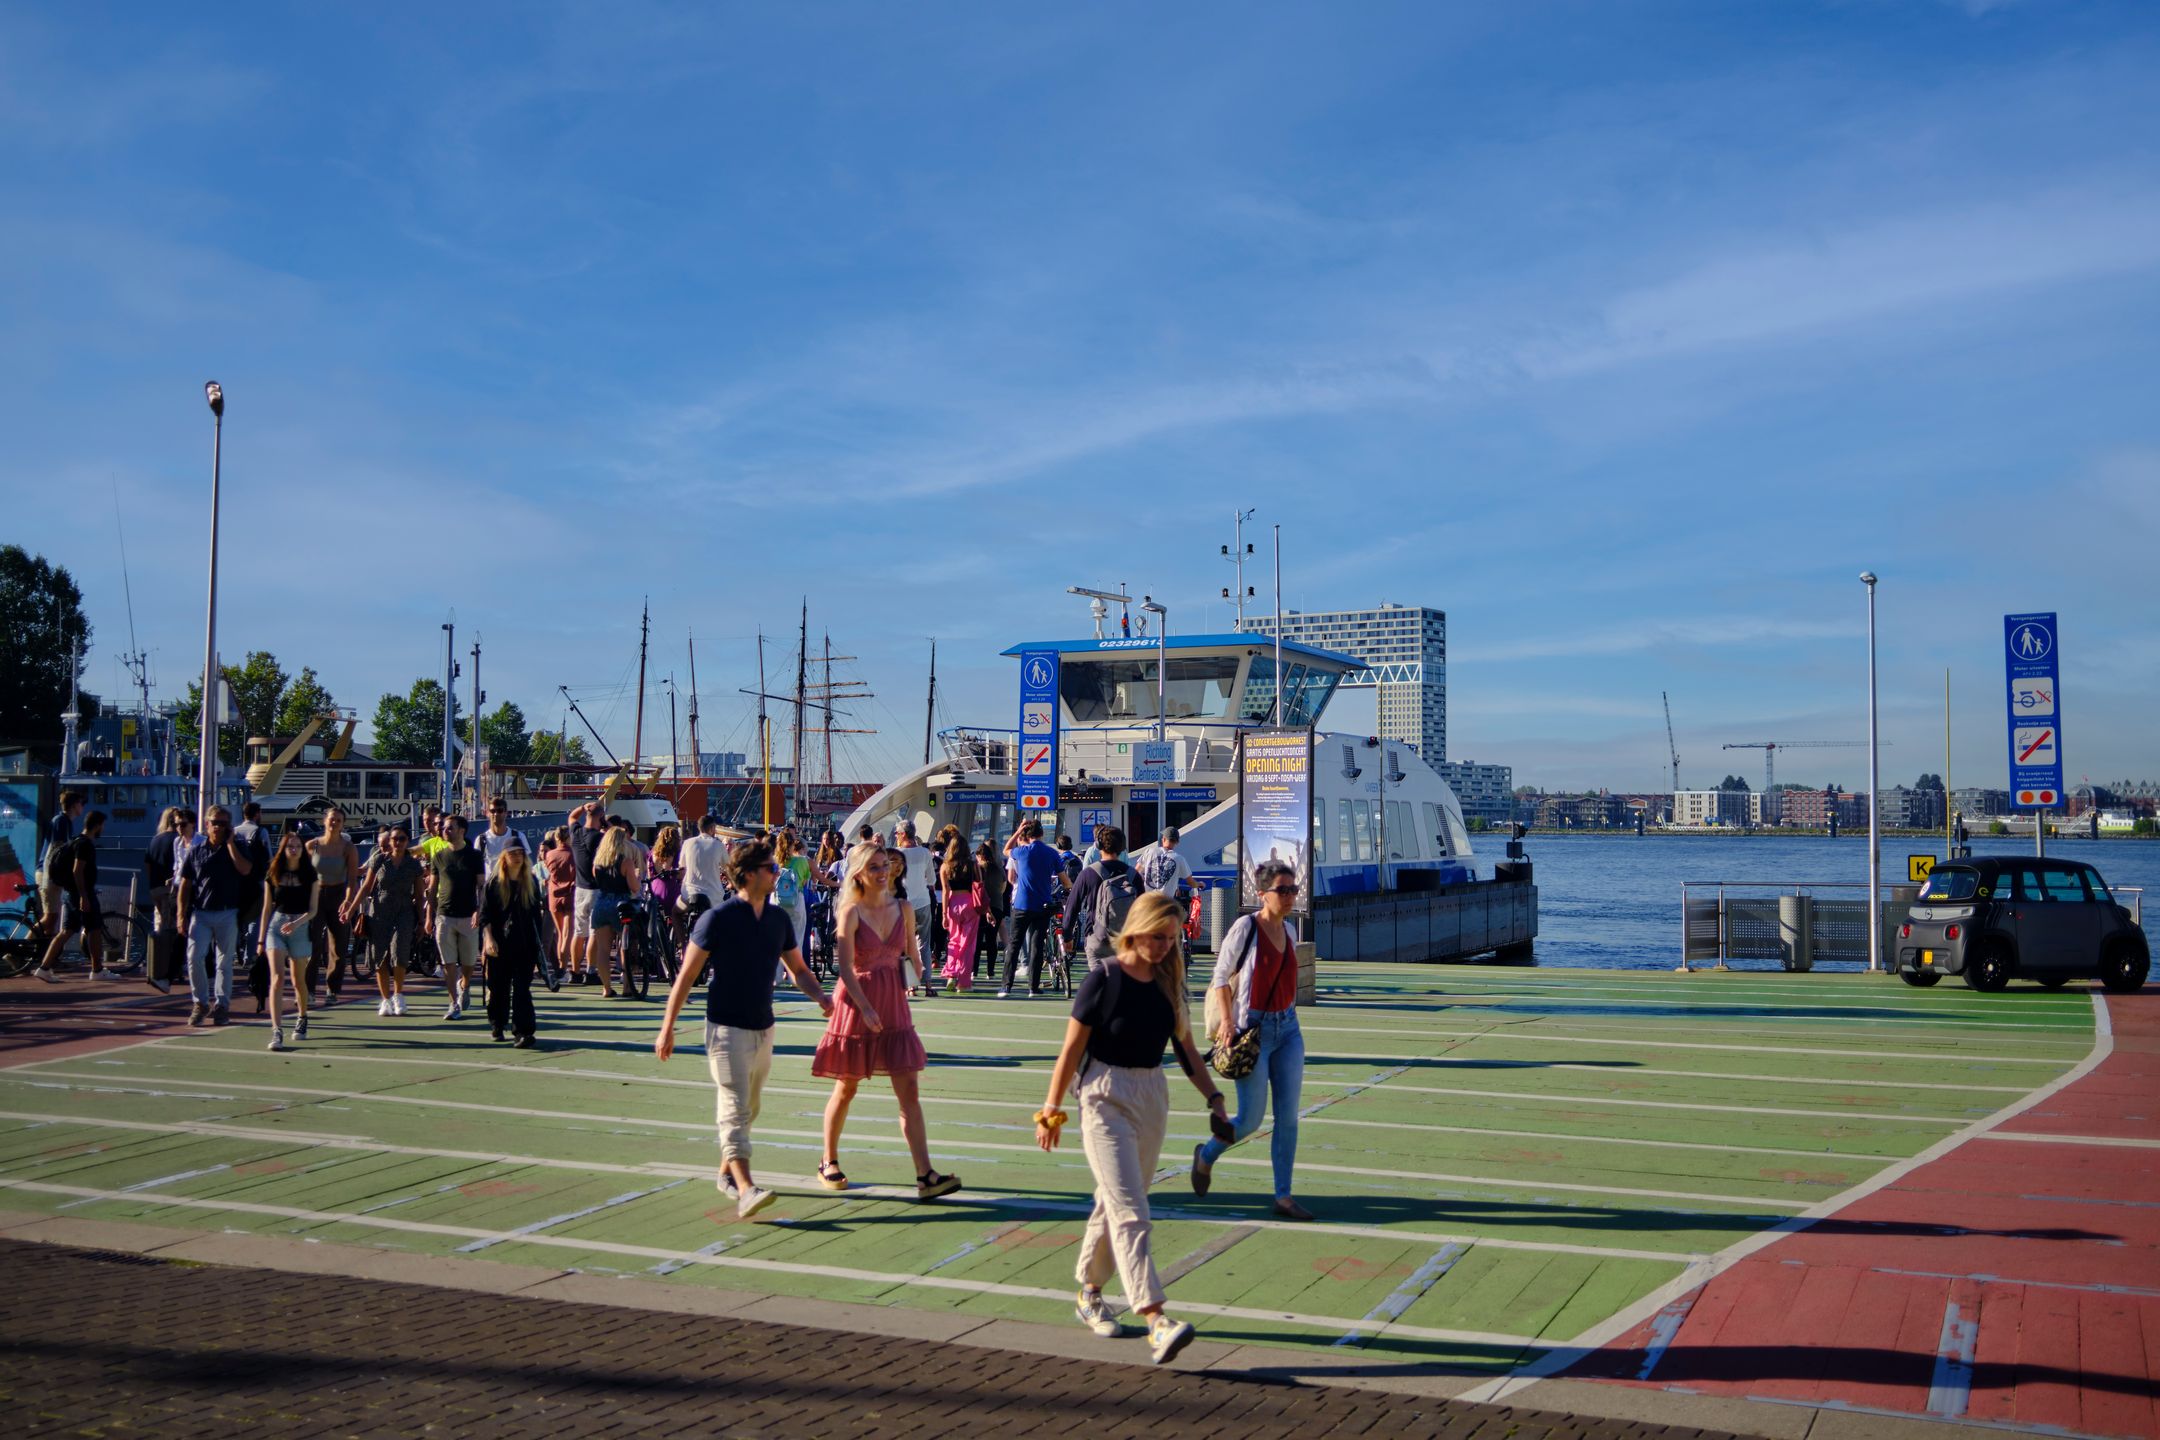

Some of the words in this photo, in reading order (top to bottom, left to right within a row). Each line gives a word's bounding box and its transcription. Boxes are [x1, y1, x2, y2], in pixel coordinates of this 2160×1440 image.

[1146, 744, 1171, 762] Richting
[1246, 748, 1262, 757] GRATIS
[1262, 747, 1306, 756] OPENLUCHTCONCERT
[1246, 759, 1280, 773] OPENING
[1282, 758, 1306, 772] NIGHT
[1134, 766, 1161, 781] Centraal
[1162, 766, 1185, 780] Staton
[1916, 862, 1929, 875] K
